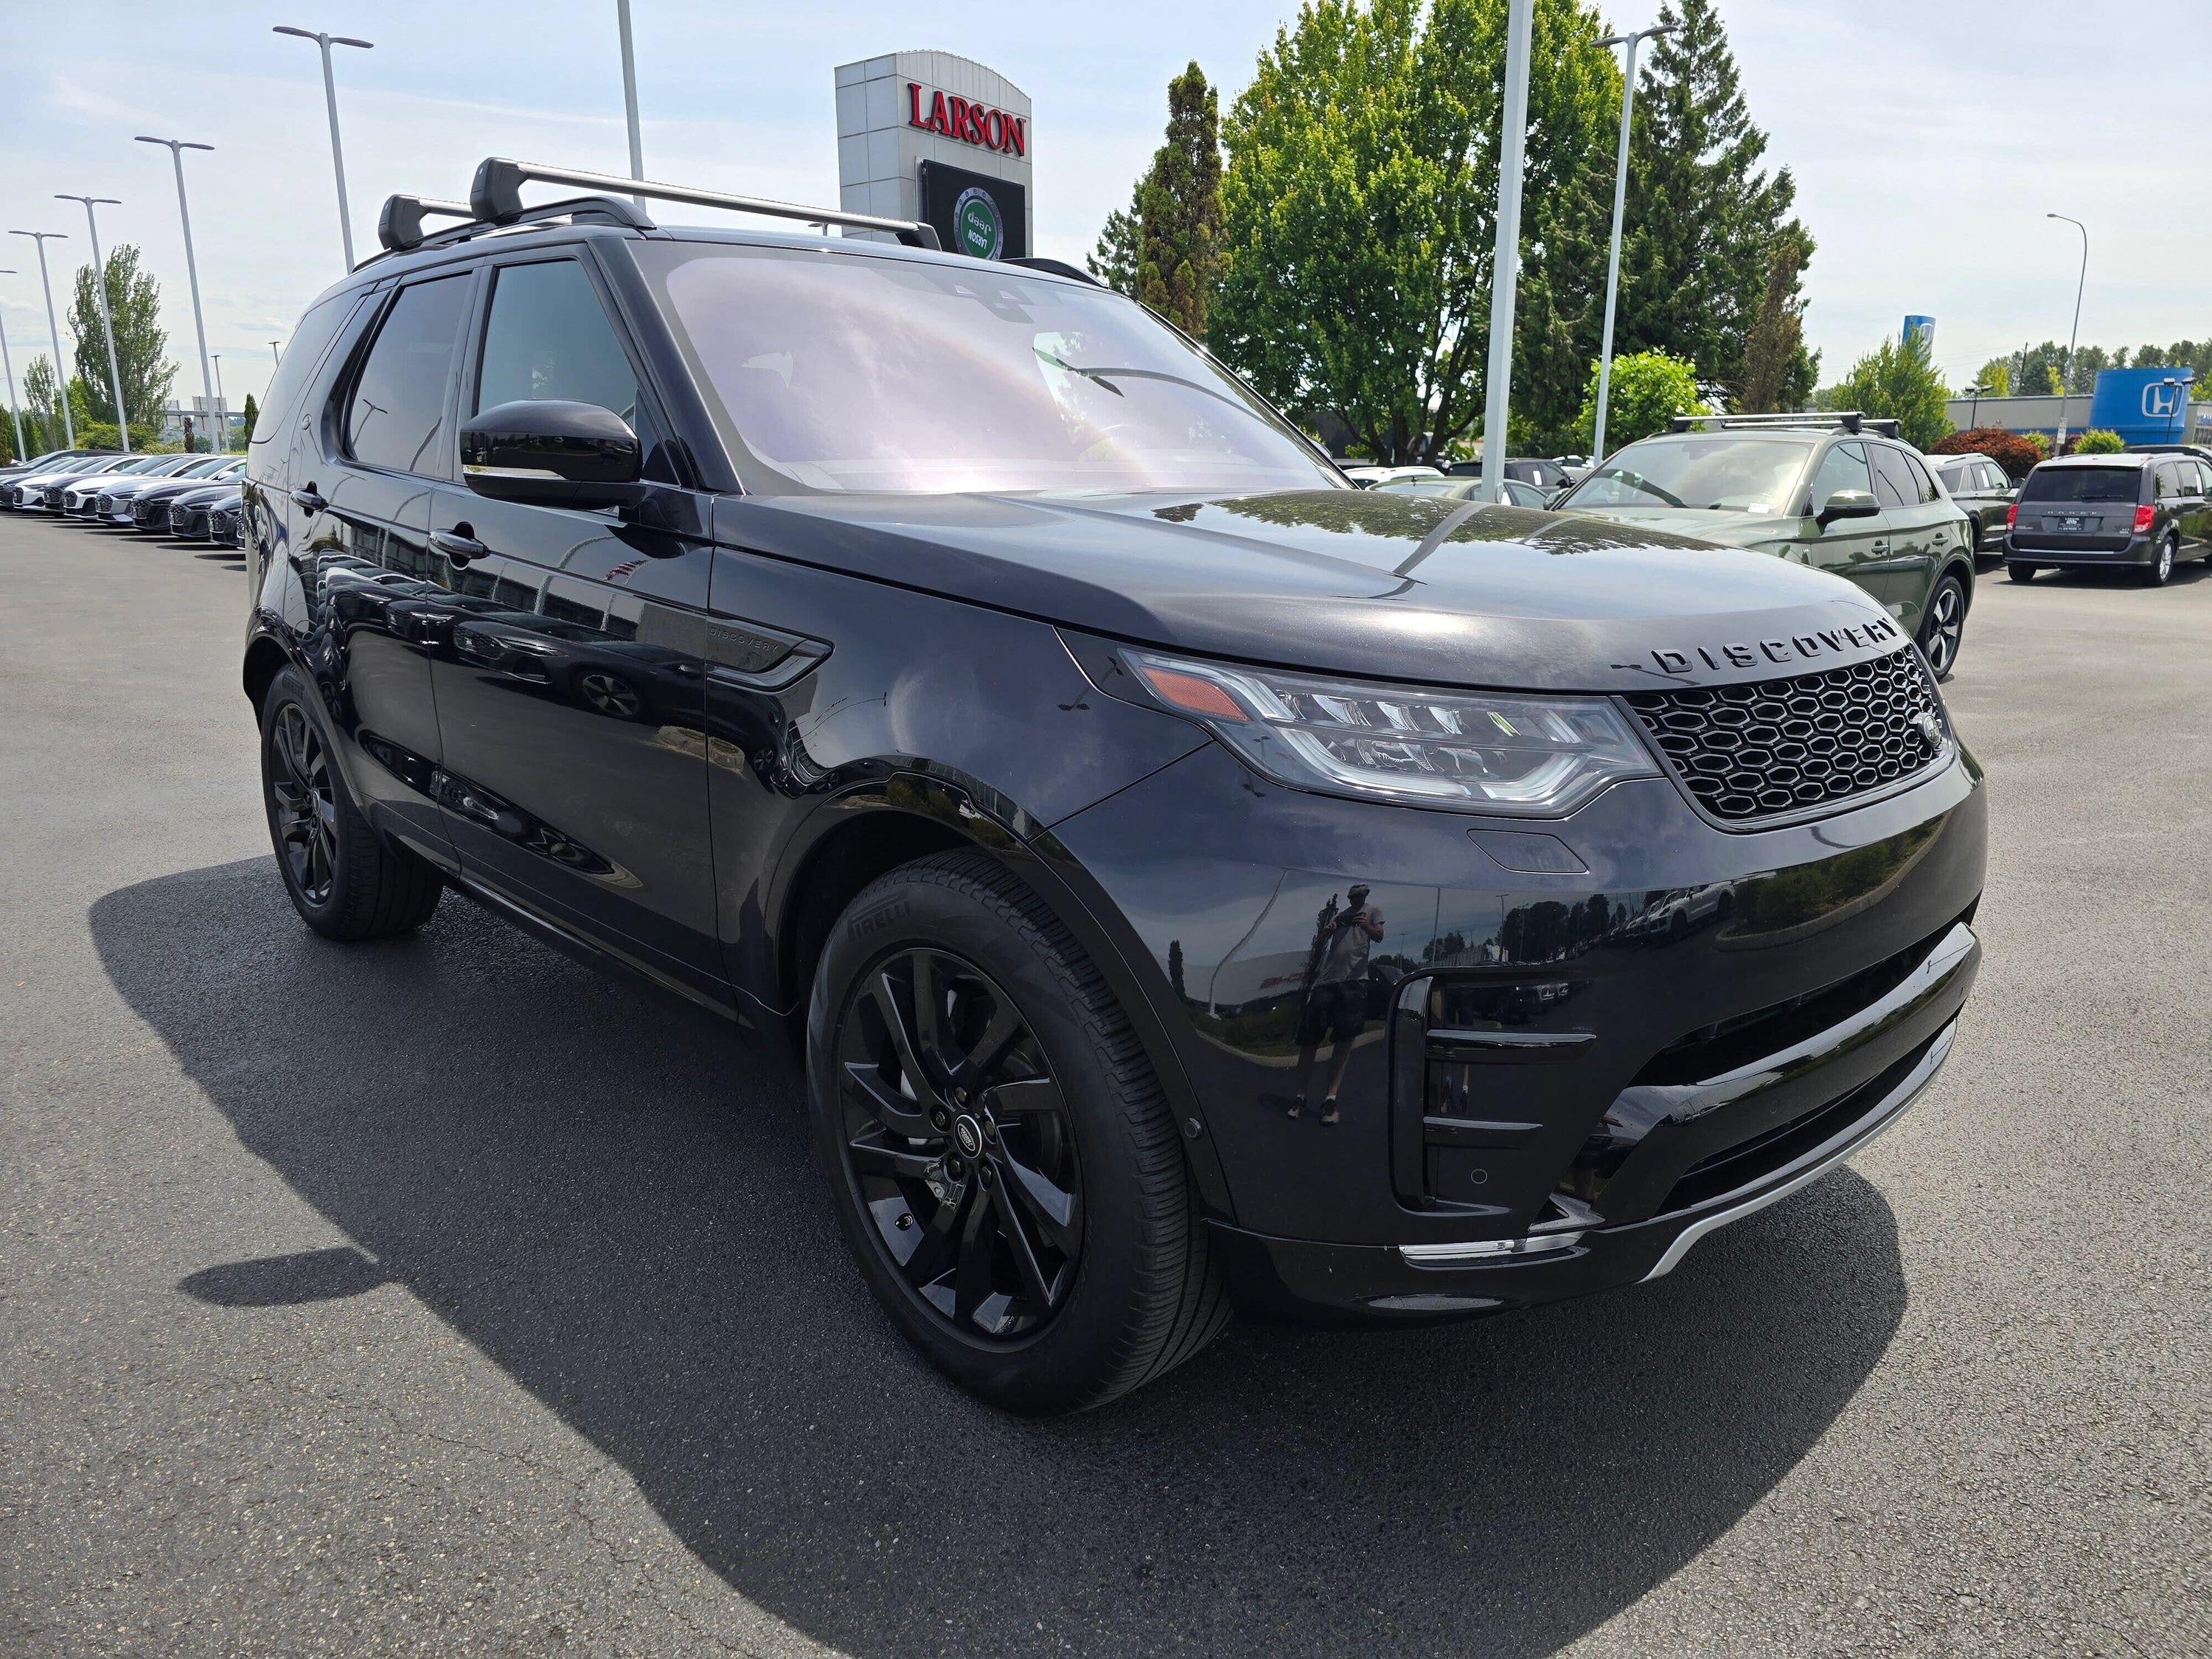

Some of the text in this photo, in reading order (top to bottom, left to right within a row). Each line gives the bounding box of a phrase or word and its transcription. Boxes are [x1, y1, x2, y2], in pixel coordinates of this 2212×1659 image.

[907, 83, 1026, 157] LARSON
[967, 211, 991, 236] Jeep
[967, 229, 988, 250] LARSON
[709, 627, 779, 653] DISCOVERY
[1651, 617, 1898, 674] DISCOVERY
[848, 891, 911, 942] PIRELLI
